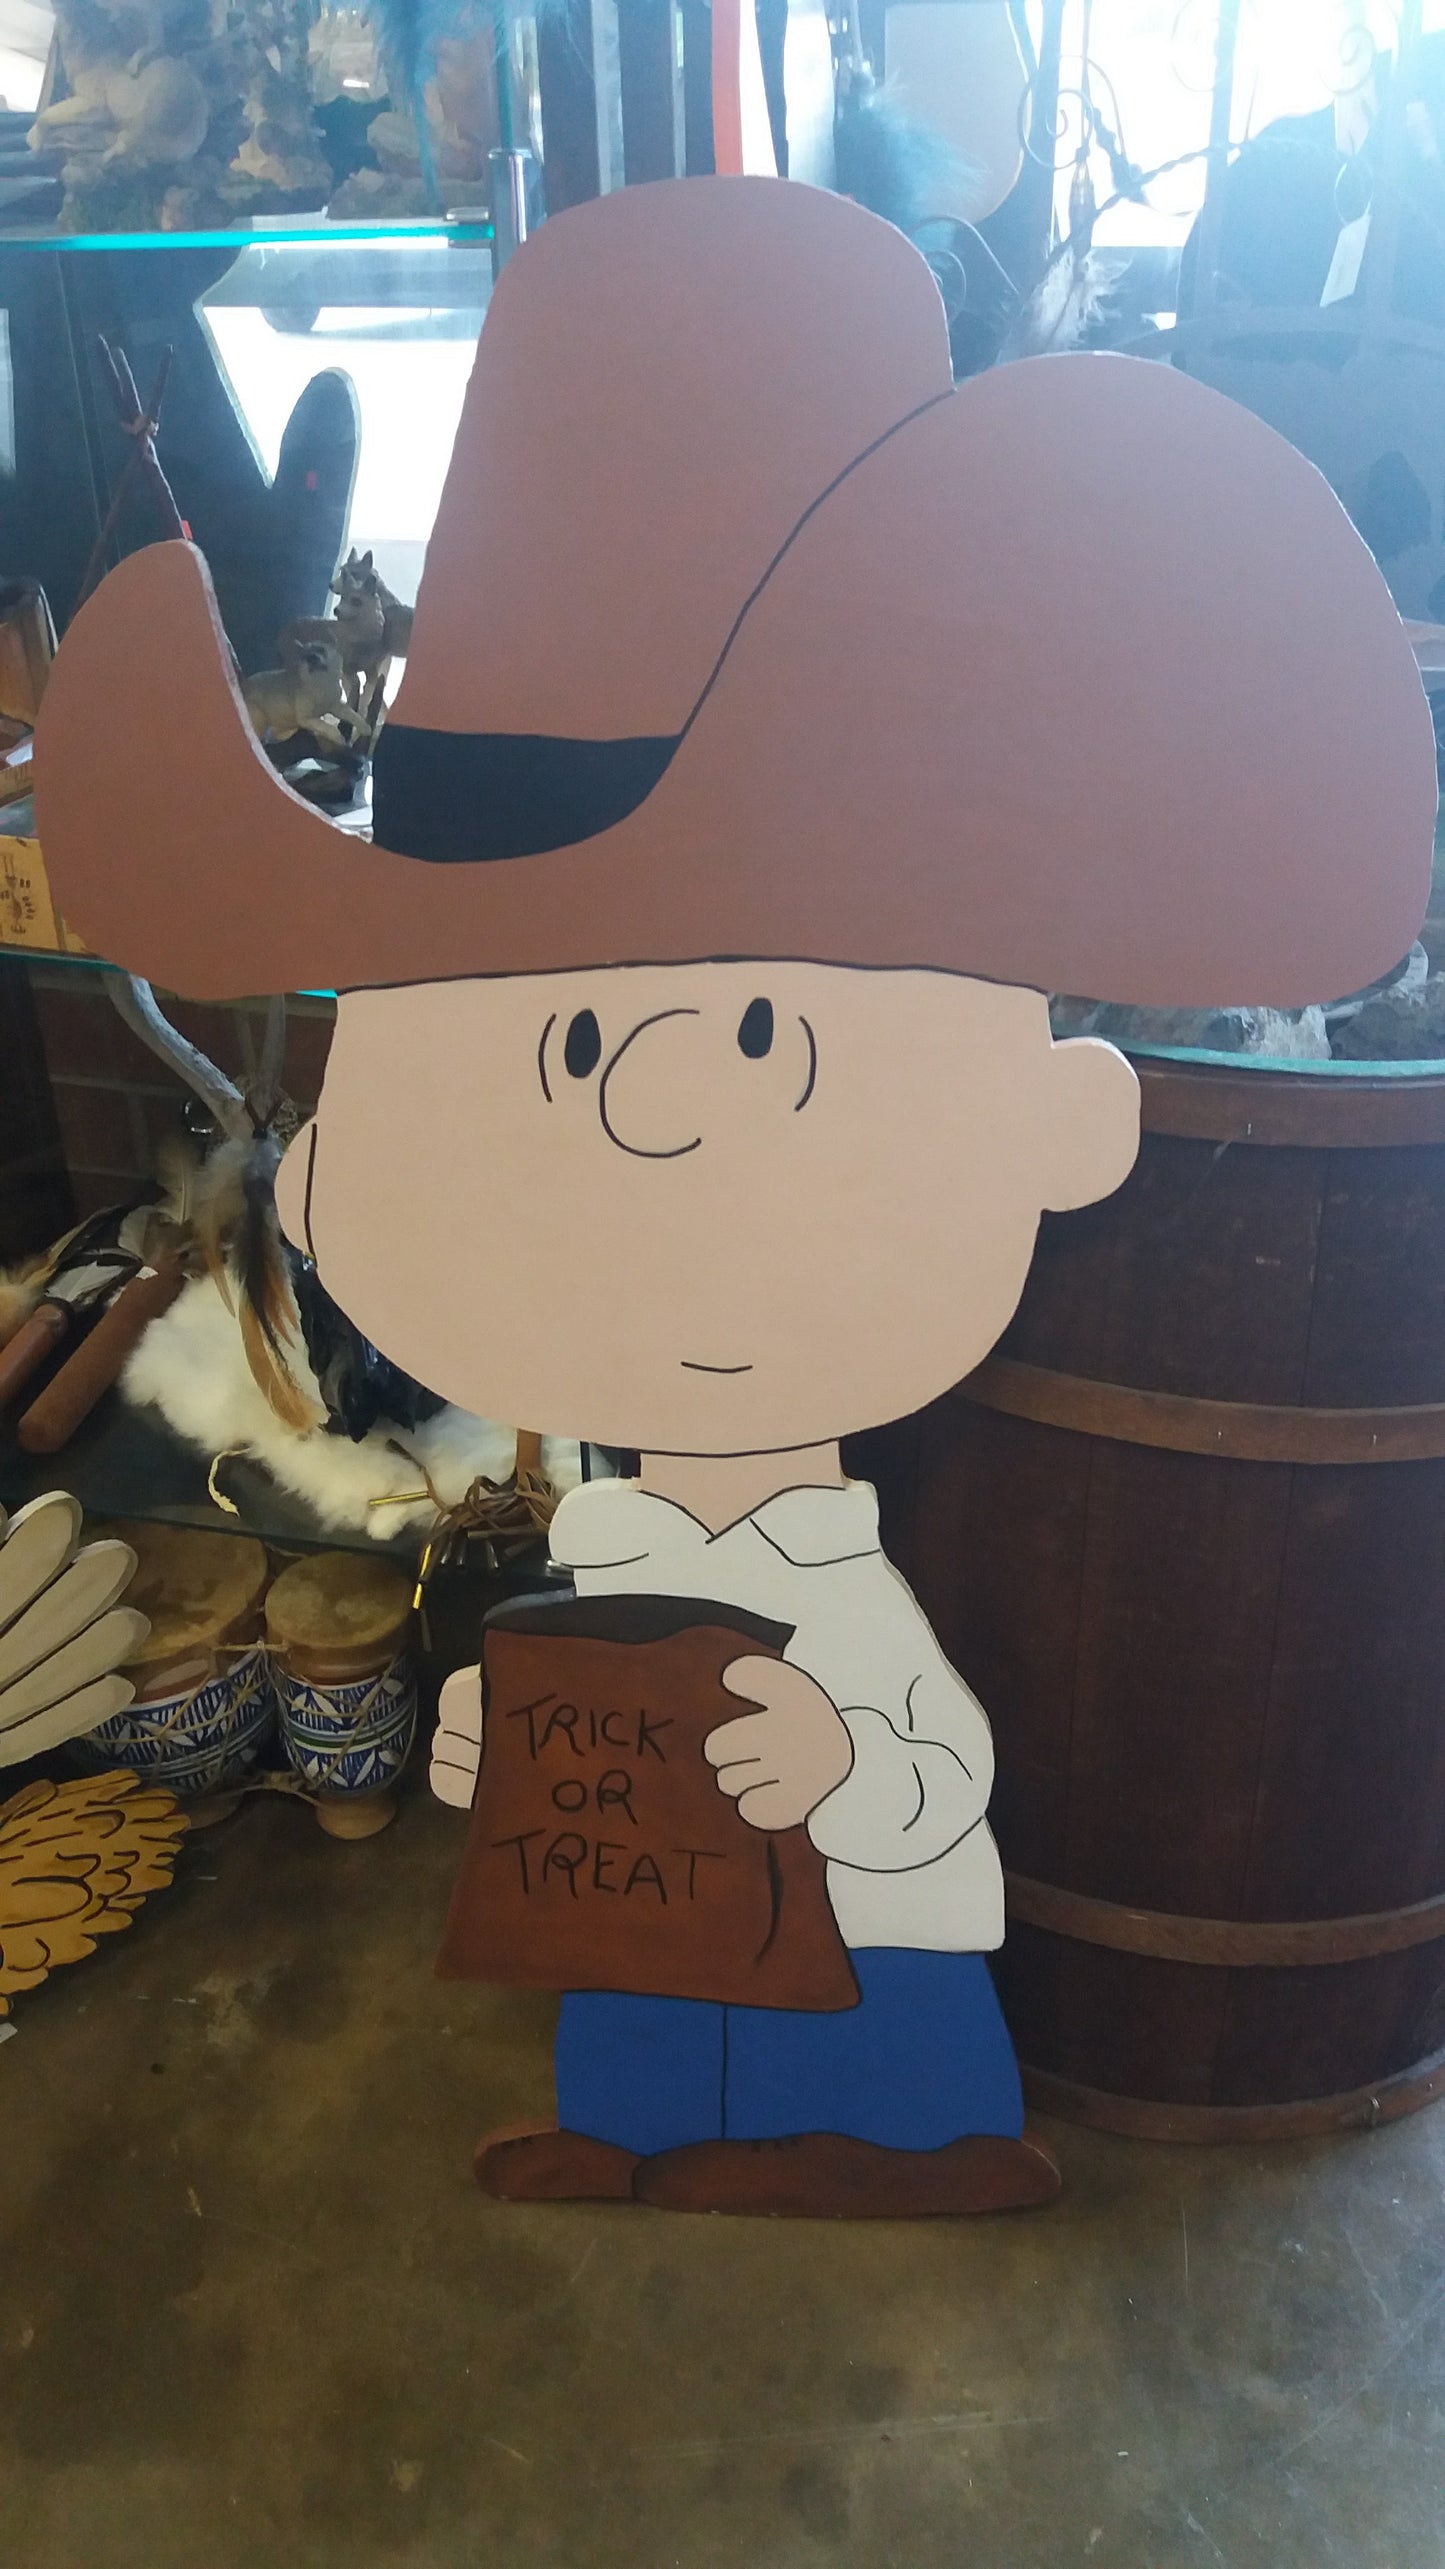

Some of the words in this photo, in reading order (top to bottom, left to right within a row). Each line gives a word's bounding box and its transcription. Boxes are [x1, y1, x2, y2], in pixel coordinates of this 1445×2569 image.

[506, 1692, 675, 1762] TRICK
[552, 1769, 639, 1826] OR
[490, 1829, 727, 1905] TREAT
